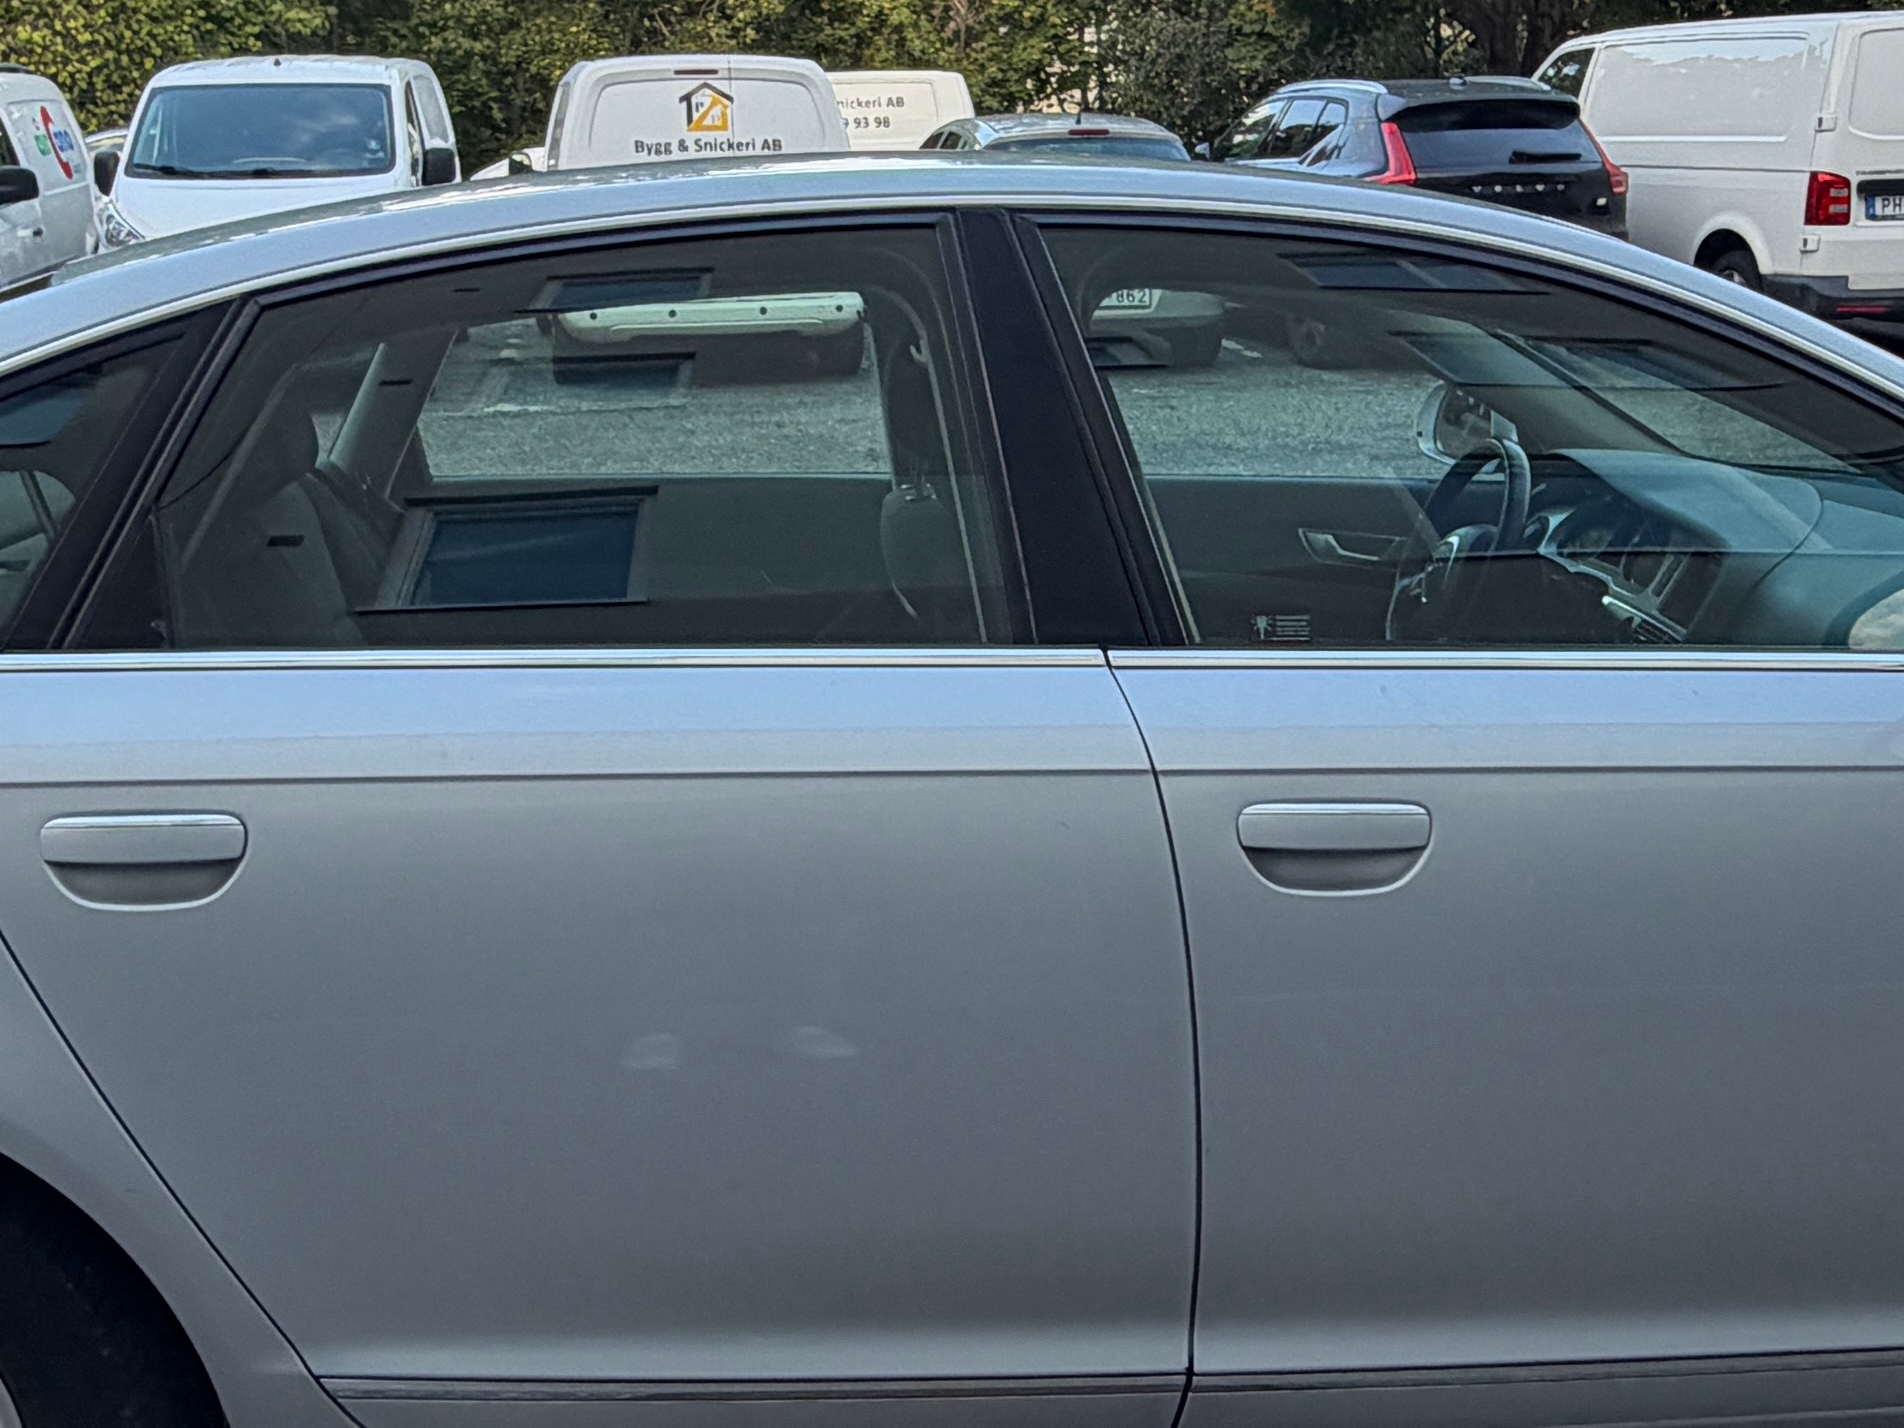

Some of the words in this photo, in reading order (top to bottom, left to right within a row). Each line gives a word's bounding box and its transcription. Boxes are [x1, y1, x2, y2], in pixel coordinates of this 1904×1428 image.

[836, 96, 881, 109] nickeri
[886, 97, 904, 108] AB
[853, 117, 869, 129] 93
[874, 116, 890, 129] 98
[634, 140, 673, 156] Bygg
[678, 138, 688, 152] &
[694, 137, 756, 153] Snickeri
[761, 138, 782, 151] AB
